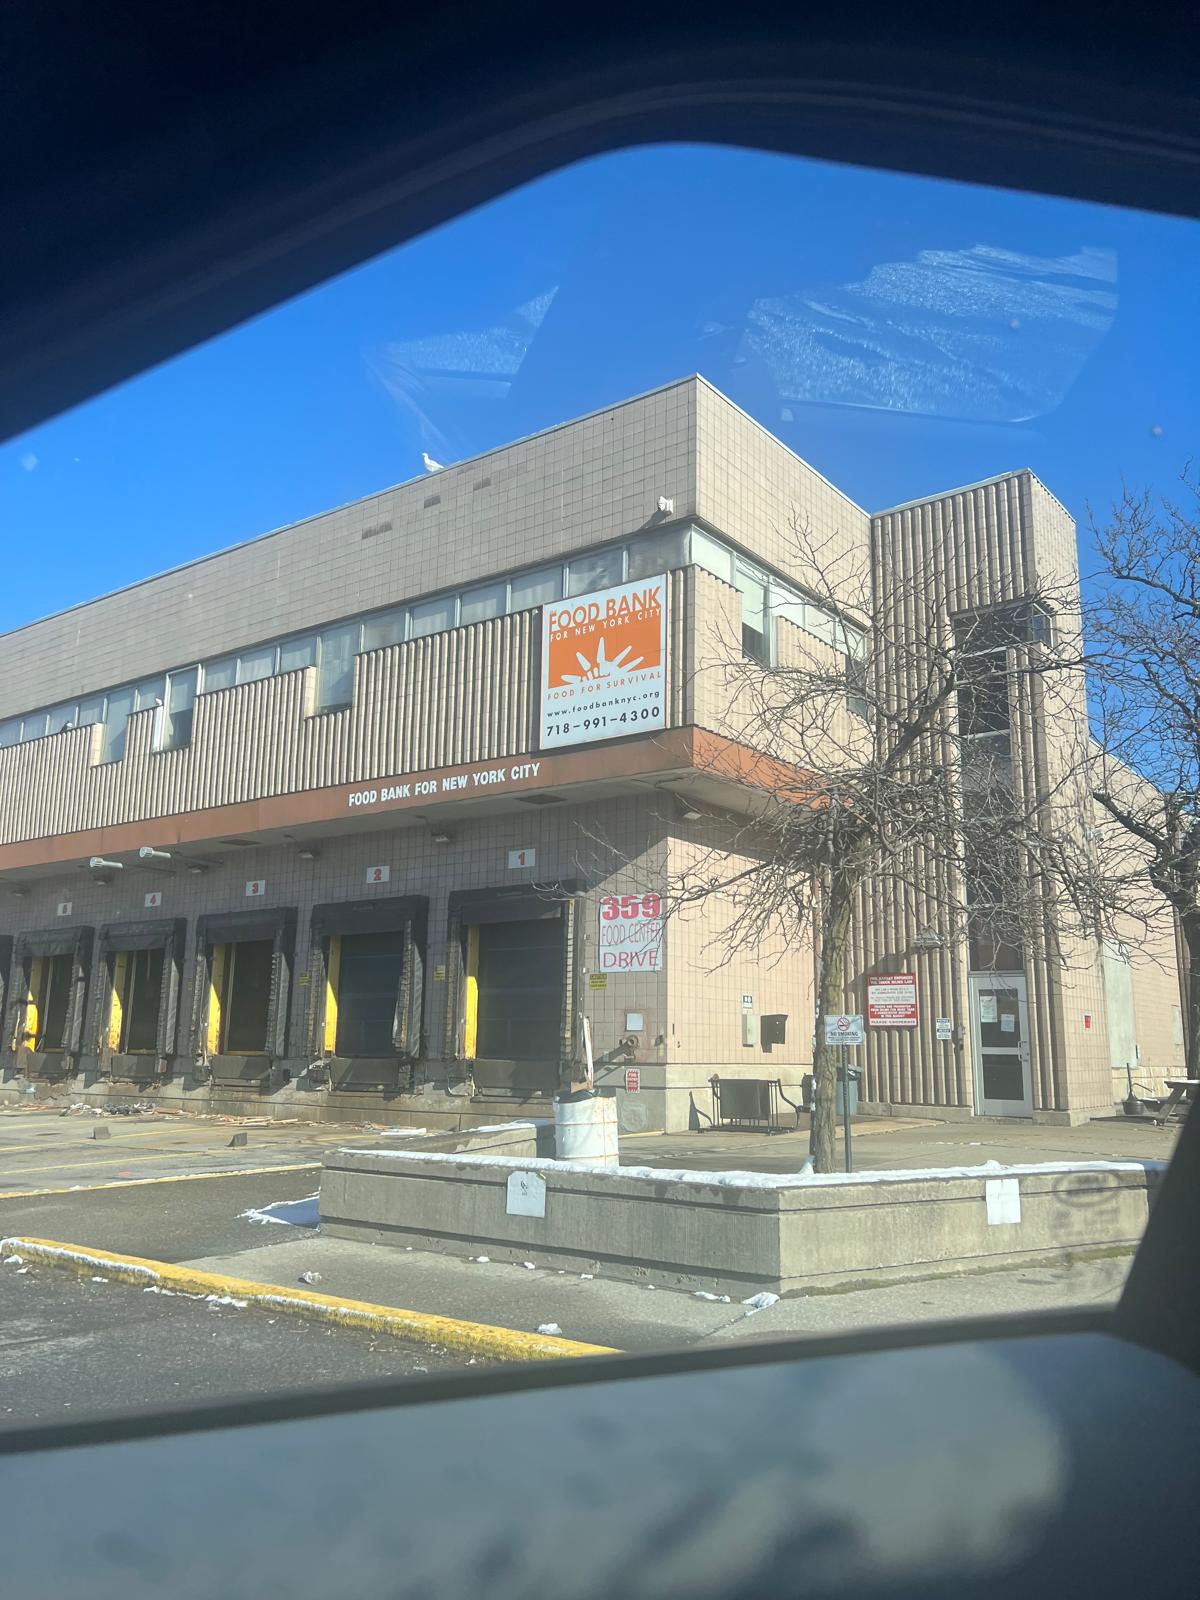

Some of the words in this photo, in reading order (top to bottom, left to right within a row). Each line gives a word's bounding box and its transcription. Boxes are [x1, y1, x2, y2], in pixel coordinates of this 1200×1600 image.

[550, 602, 600, 632] FOOD
[606, 586, 661, 618] BANK
[551, 631, 568, 642] FOR
[575, 625, 595, 636] NEW
[603, 615, 630, 629] YORK
[638, 607, 661, 621] CITY
[548, 689, 575, 701] FOOD
[582, 683, 601, 694] FOR
[606, 671, 661, 689] SURVIVAL
[547, 690, 660, 717] www.foodbanknyc.org
[547, 706, 660, 736] 718-991-4300
[349, 790, 377, 806] FOOD
[381, 784, 410, 801] BANK
[415, 780, 437, 796] FOR
[442, 775, 468, 791] NEW
[473, 768, 505, 786] YORK
[511, 763, 540, 780] CITY
[518, 851, 525, 865] 1
[251, 882, 259, 894] 3
[373, 868, 382, 881] 2
[602, 893, 661, 921] 359
[601, 924, 626, 946] FOOD
[628, 922, 661, 943] CENTER
[603, 950, 660, 968] DRIVE
